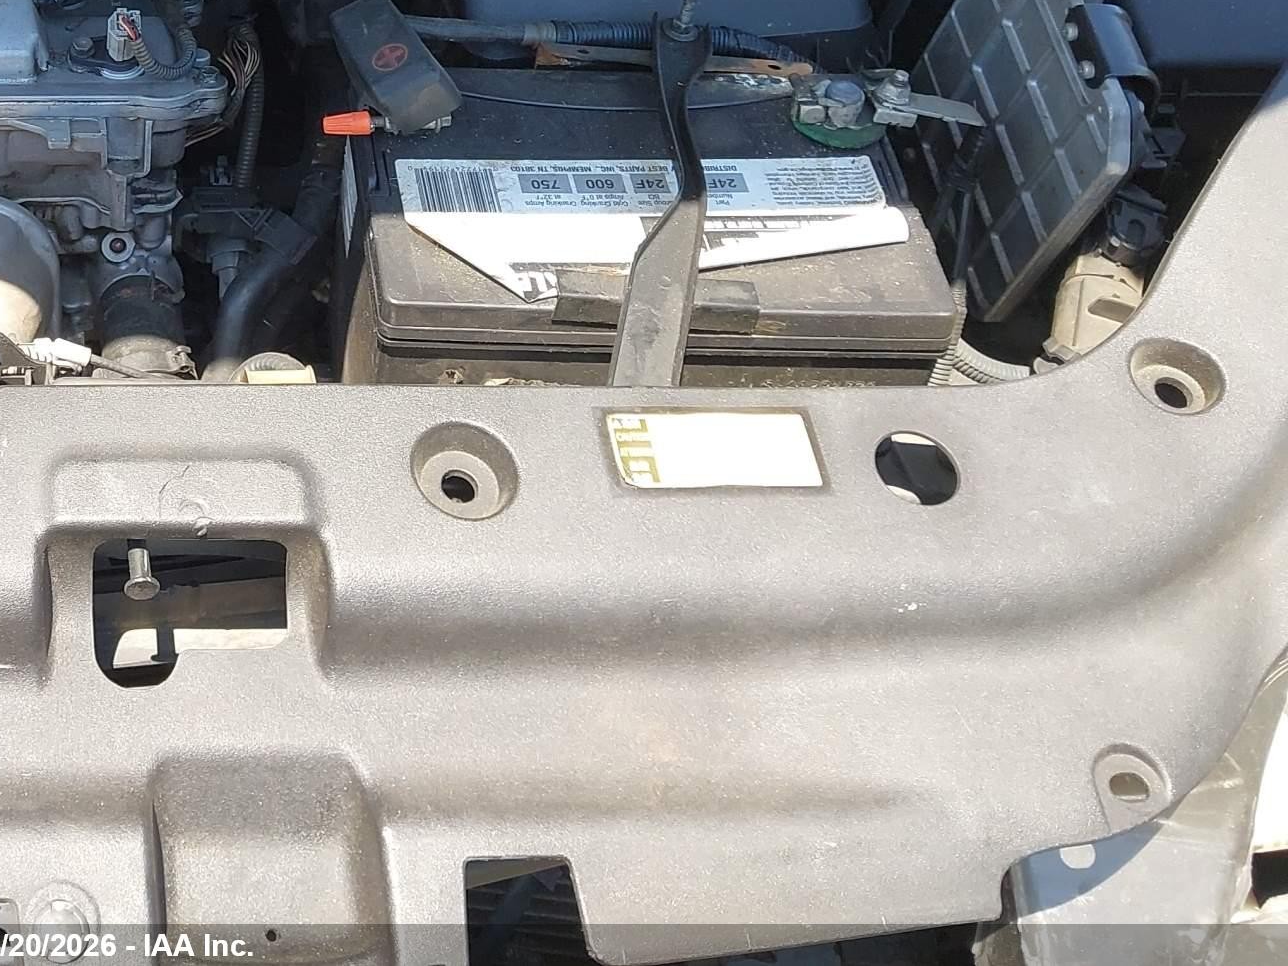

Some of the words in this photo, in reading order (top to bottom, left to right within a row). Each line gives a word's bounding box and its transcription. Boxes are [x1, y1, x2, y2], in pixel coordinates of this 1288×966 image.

[531, 180, 560, 189] 750
[586, 179, 613, 189] 600
[636, 179, 664, 189] 24F
[708, 179, 737, 188] 24F
